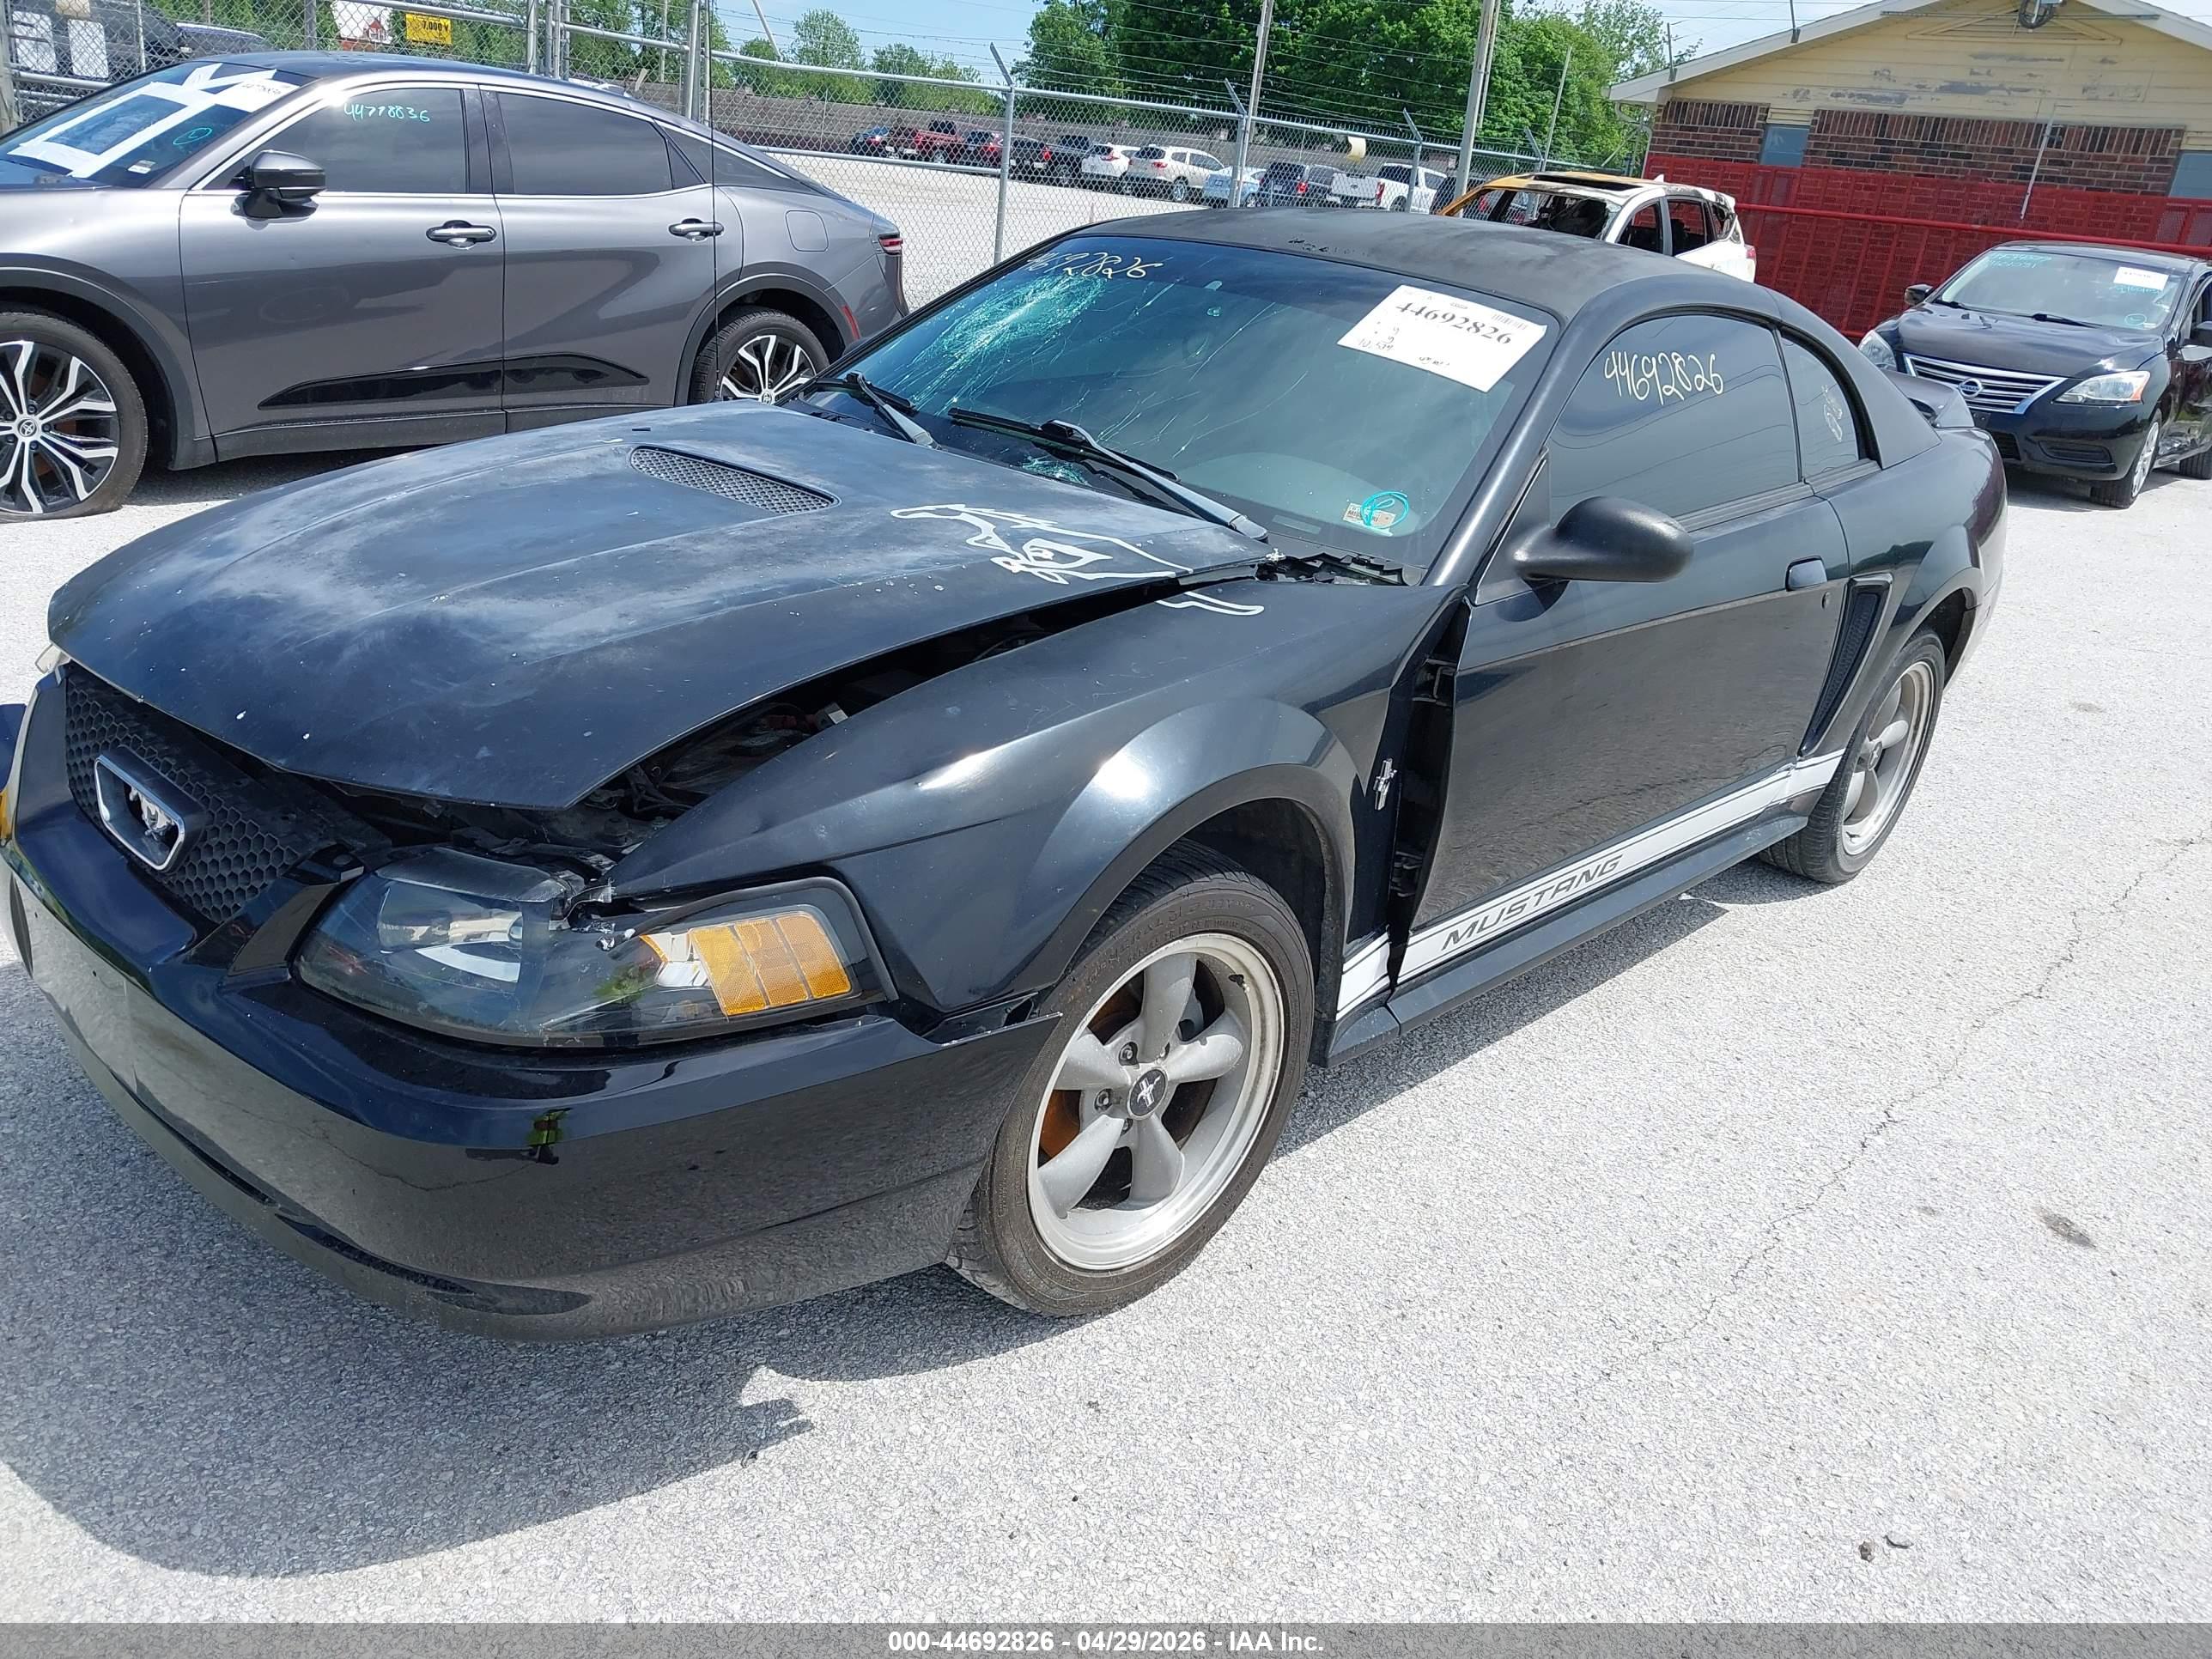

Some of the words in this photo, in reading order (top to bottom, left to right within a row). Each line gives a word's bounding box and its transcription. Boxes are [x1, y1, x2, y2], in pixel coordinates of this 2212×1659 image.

[1395, 301, 1511, 344] 44692826
[1604, 350, 1724, 405] 44692826
[1441, 854, 1623, 951] MUSTANG
